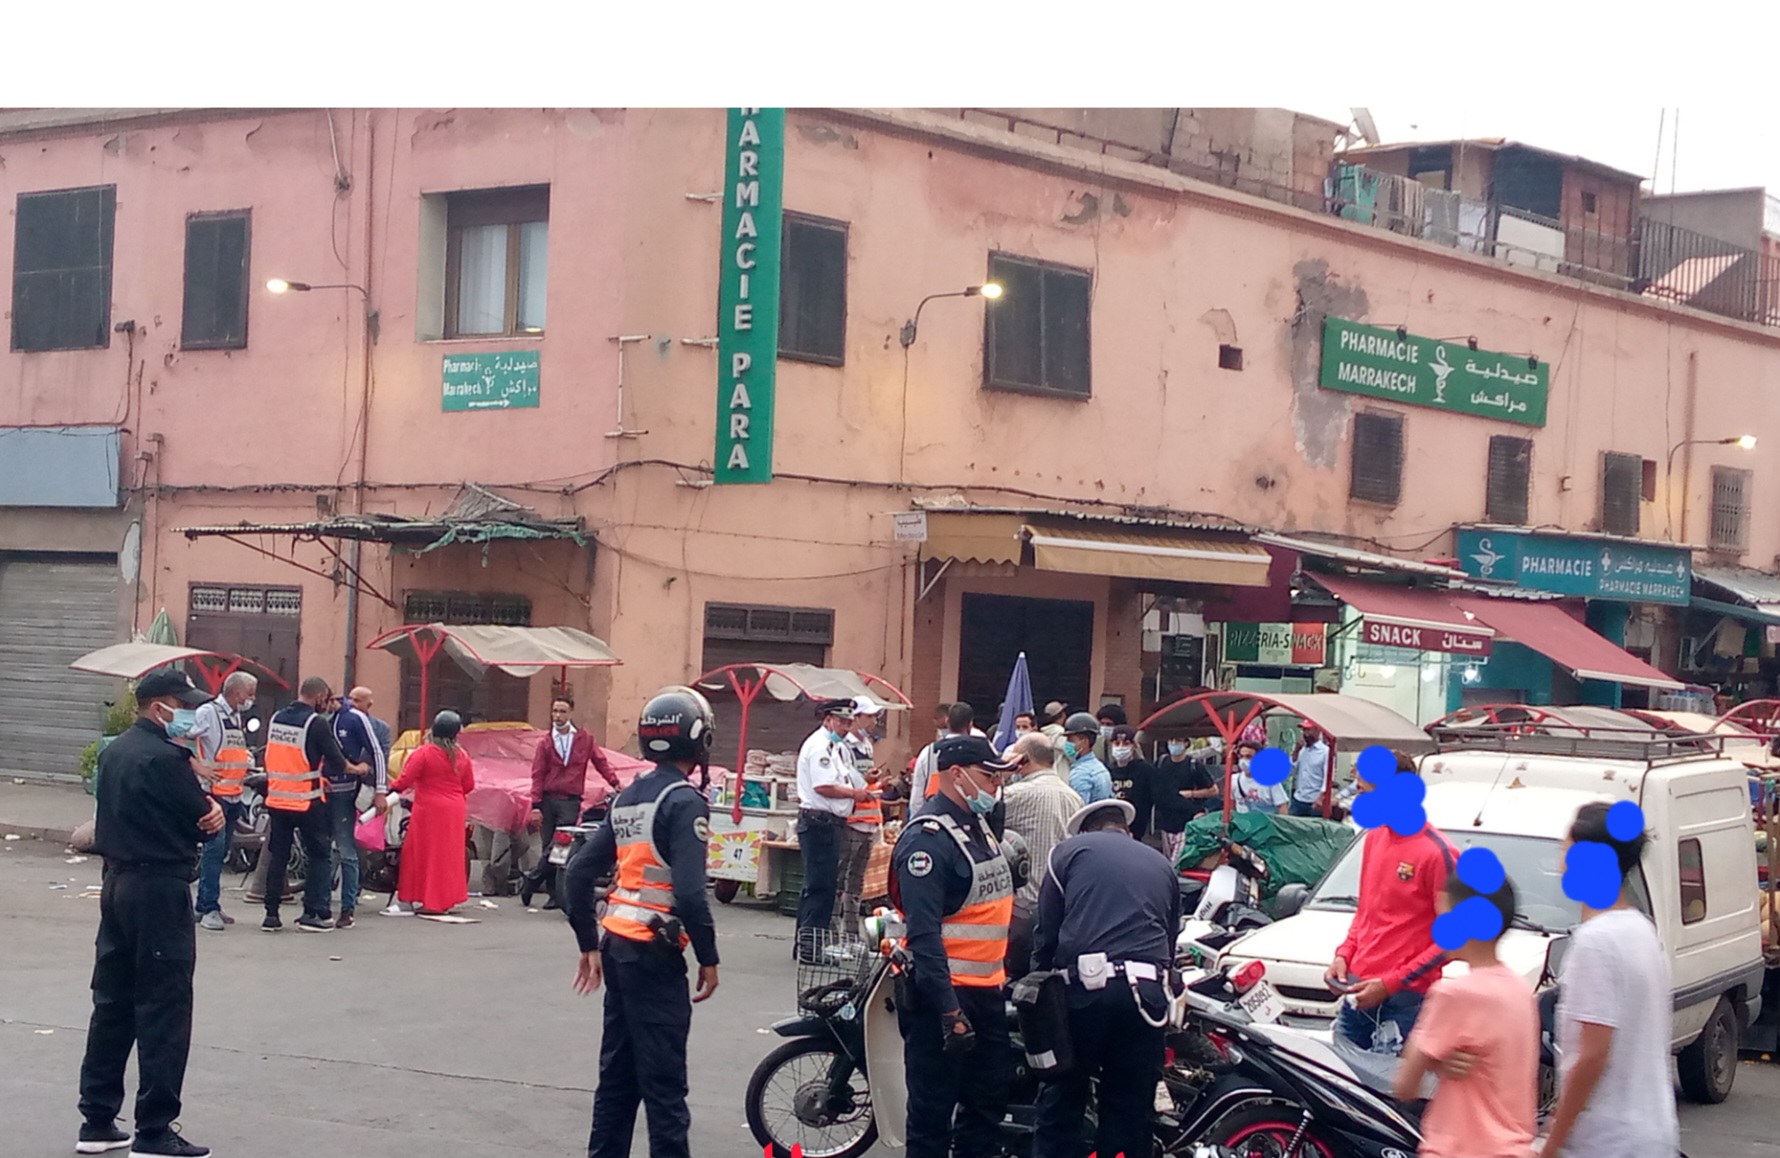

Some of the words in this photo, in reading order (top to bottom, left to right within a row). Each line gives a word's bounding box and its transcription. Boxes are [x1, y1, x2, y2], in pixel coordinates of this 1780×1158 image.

[1340, 330, 1419, 363] PHARMACIE
[495, 356, 538, 375] صيدلية
[1465, 358, 1538, 386] صيدلية
[1338, 361, 1416, 393] MARRAKECH
[443, 381, 482, 397] Marrakech
[501, 380, 537, 398] مراكش
[1470, 389, 1527, 413] مراكش
[727, 353, 752, 471] PARA
[1522, 556, 1592, 577] PHARMACIE
[1599, 578, 1641, 595] PHARMACIE
[1642, 582, 1685, 599] MARRAKECH
[1370, 624, 1421, 646] SNACK
[270, 733, 297, 744] POLICE
[733, 848, 743, 861] 47
